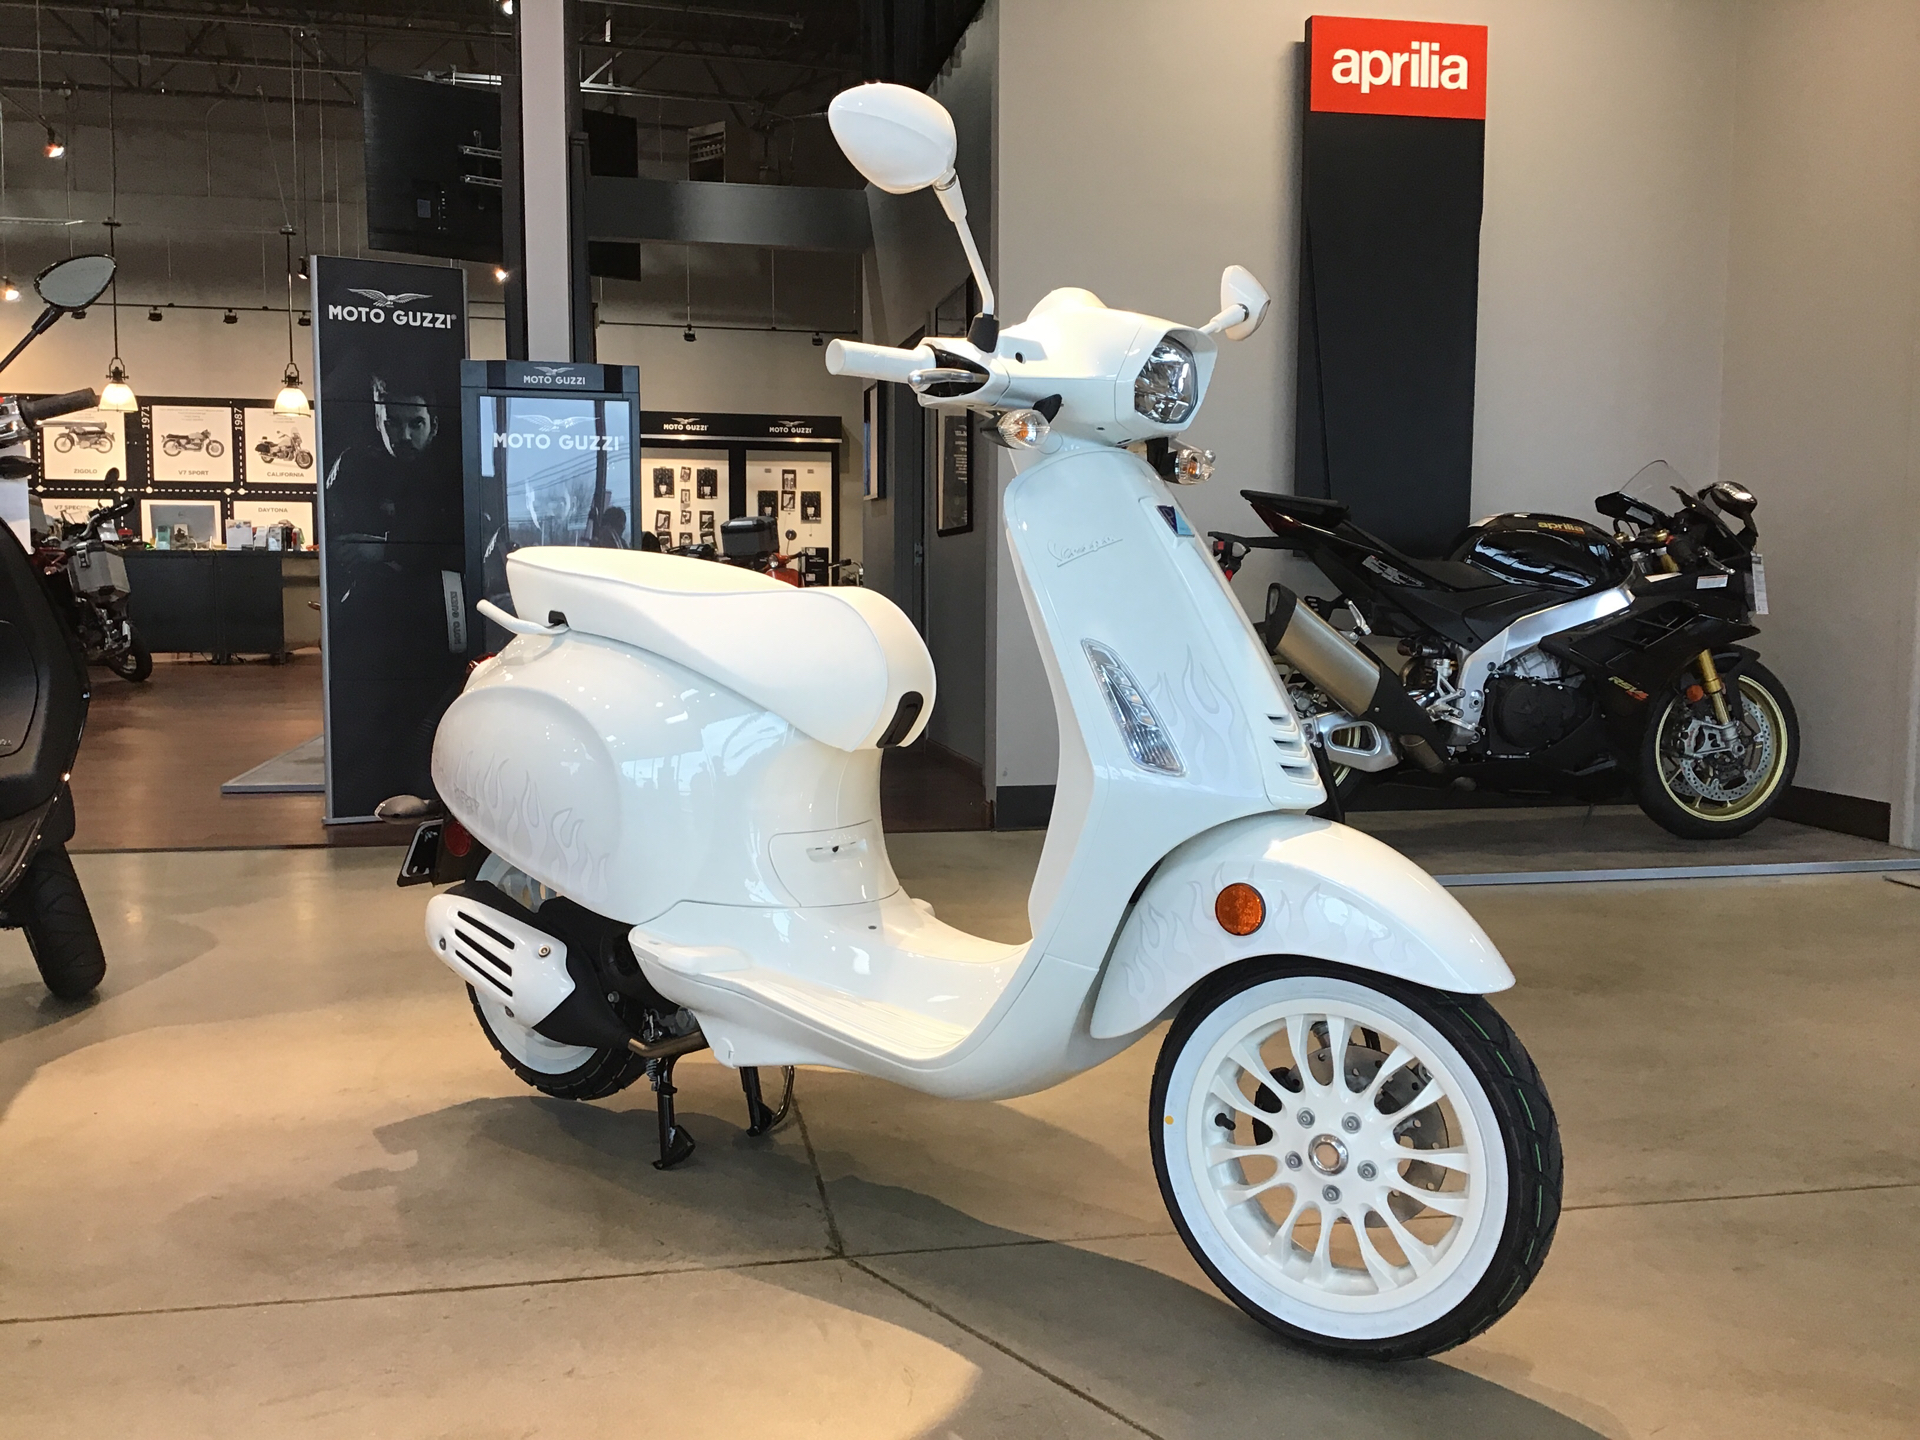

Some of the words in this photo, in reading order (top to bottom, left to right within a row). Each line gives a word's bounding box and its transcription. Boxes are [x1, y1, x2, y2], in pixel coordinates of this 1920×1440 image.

[1331, 40, 1469, 94] aprilia
[328, 304, 385, 324] MOTO
[392, 309, 452, 329] GUZZI
[523, 375, 552, 385] MOTO
[555, 375, 586, 385] GUZZI
[140, 405, 151, 430] 1971
[233, 407, 244, 432] 1987
[663, 423, 684, 431] MOTO
[685, 424, 708, 432] GUZZI
[769, 426, 789, 434] MOTO
[493, 432, 551, 449] MOTO
[558, 434, 620, 451] GUZZI
[1537, 521, 1585, 533] aprilia
